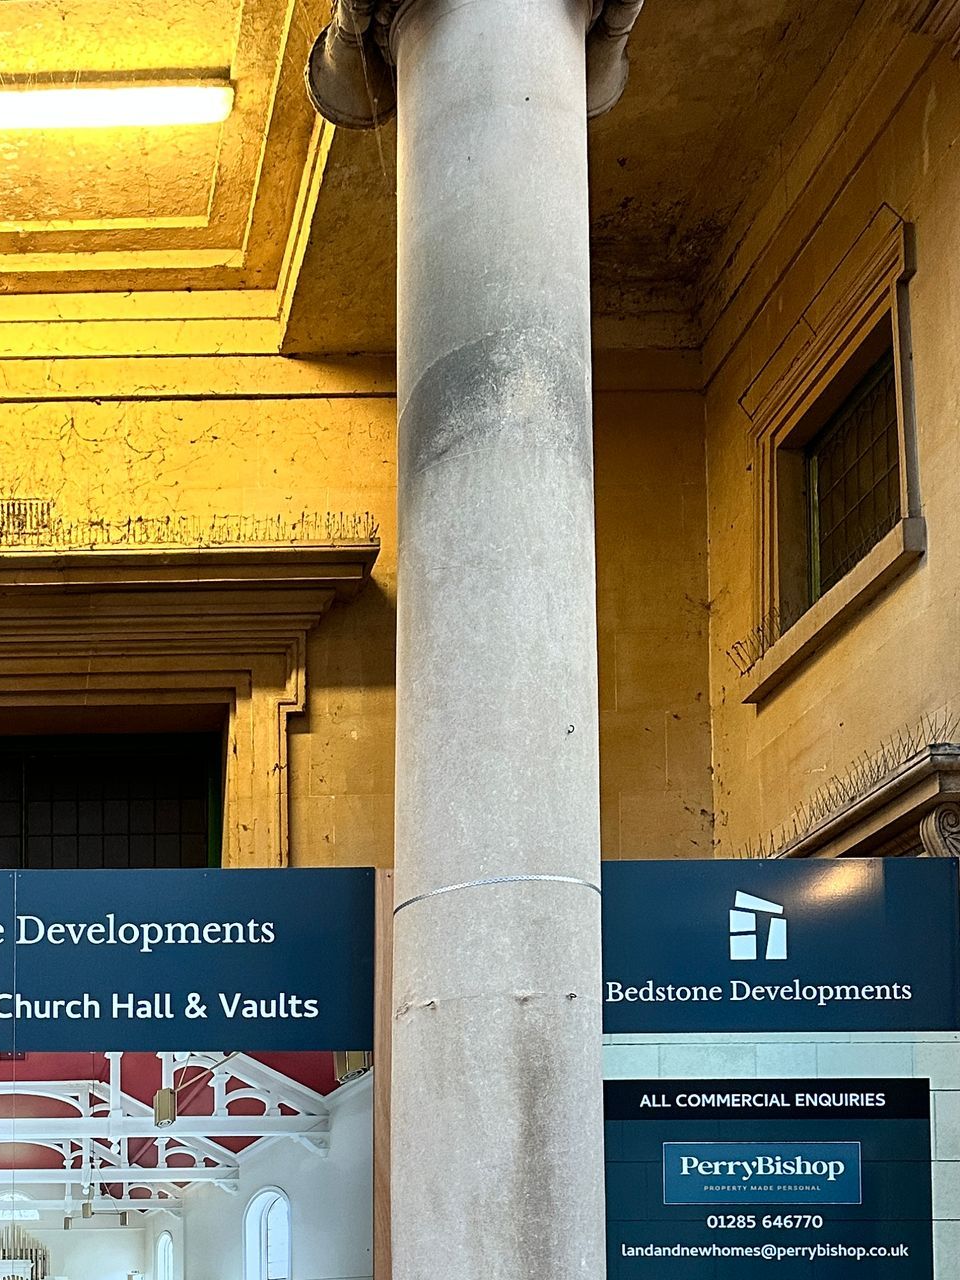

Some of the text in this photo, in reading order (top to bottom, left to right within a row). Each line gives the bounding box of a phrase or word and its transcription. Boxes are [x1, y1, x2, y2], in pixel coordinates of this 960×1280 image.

[14, 913, 275, 953] Developments
[605, 978, 912, 1006] Bedstone Developments
[112, 993, 175, 1019] Hall
[184, 992, 208, 1019] &
[218, 992, 319, 1018] Vaults
[639, 1092, 886, 1108] ALL COMMERCIAL ENQUIRIES
[679, 1155, 845, 1181] PerryBishop
[706, 1214, 824, 1229] 01285 646770
[621, 1243, 909, 1261] landandnewhomes@perrybishop.co.uk
